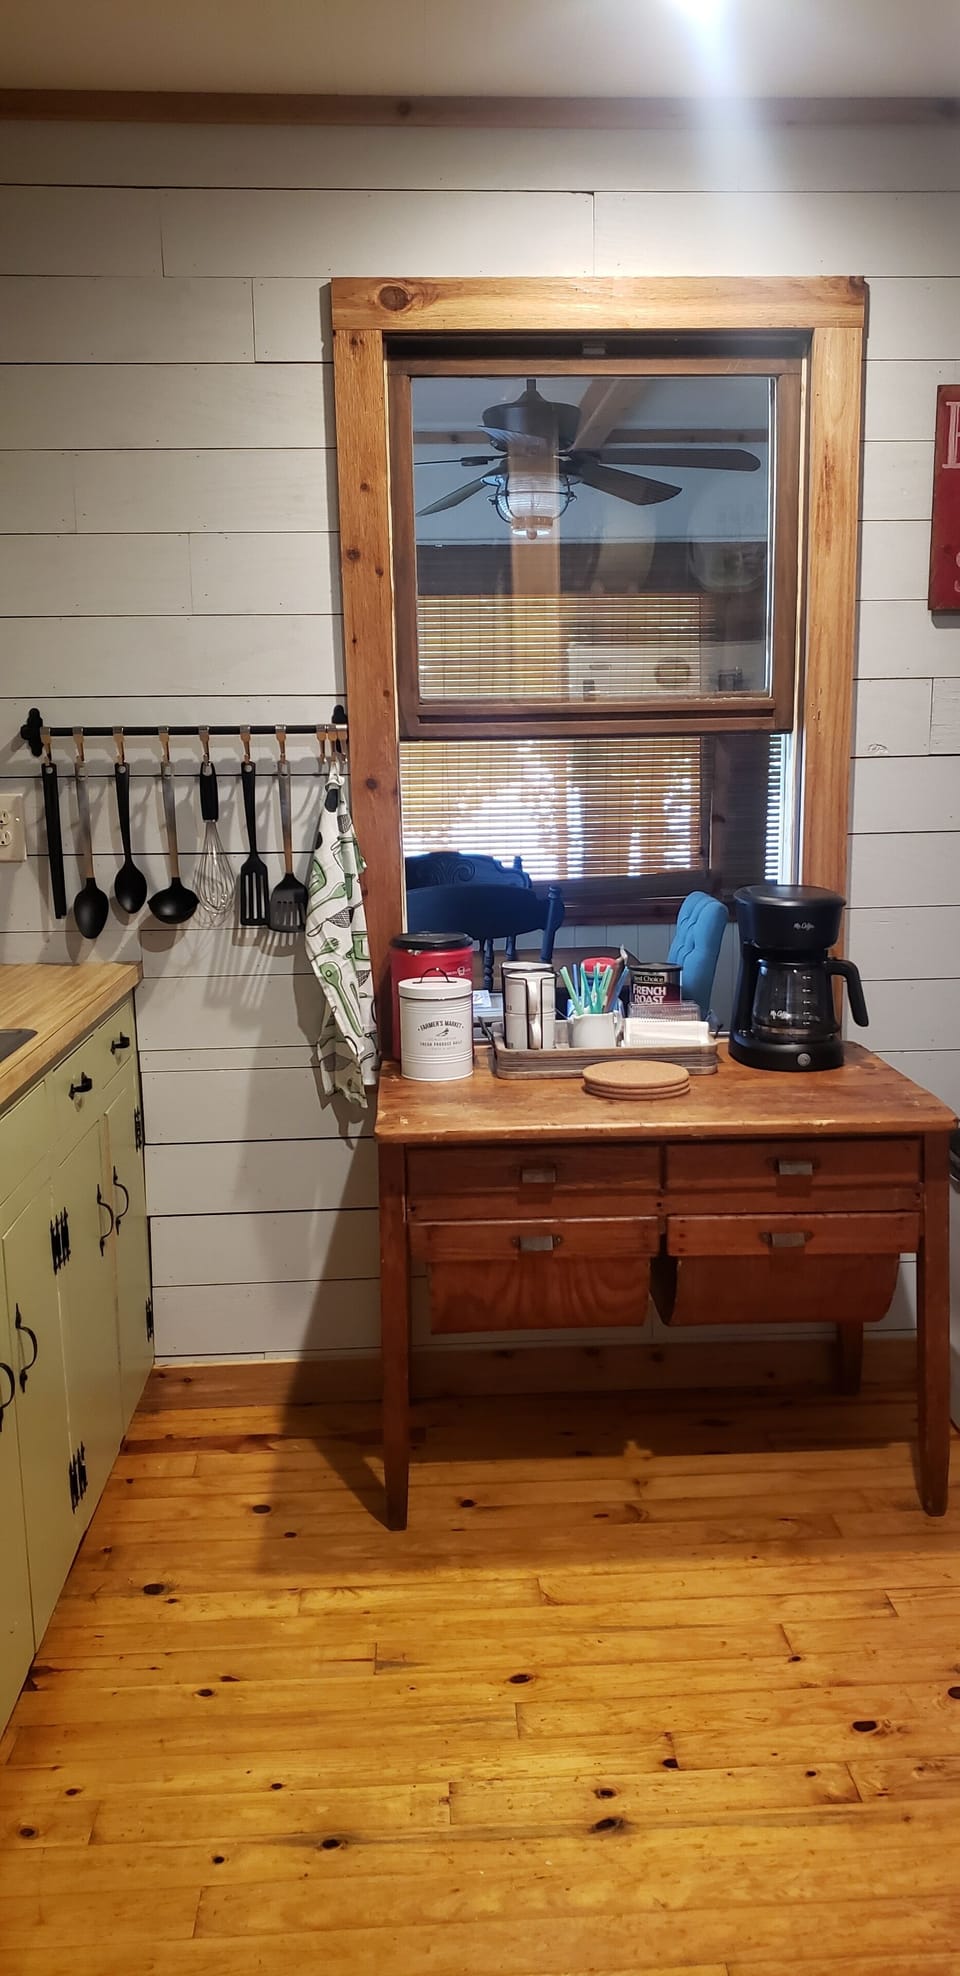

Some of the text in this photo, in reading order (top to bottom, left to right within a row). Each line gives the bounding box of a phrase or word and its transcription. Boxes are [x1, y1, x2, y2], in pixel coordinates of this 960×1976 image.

[632, 983, 666, 996] FRENCH
[634, 994, 664, 1004] ROAST
[420, 1020, 462, 1030] FARMER'S MARKET
